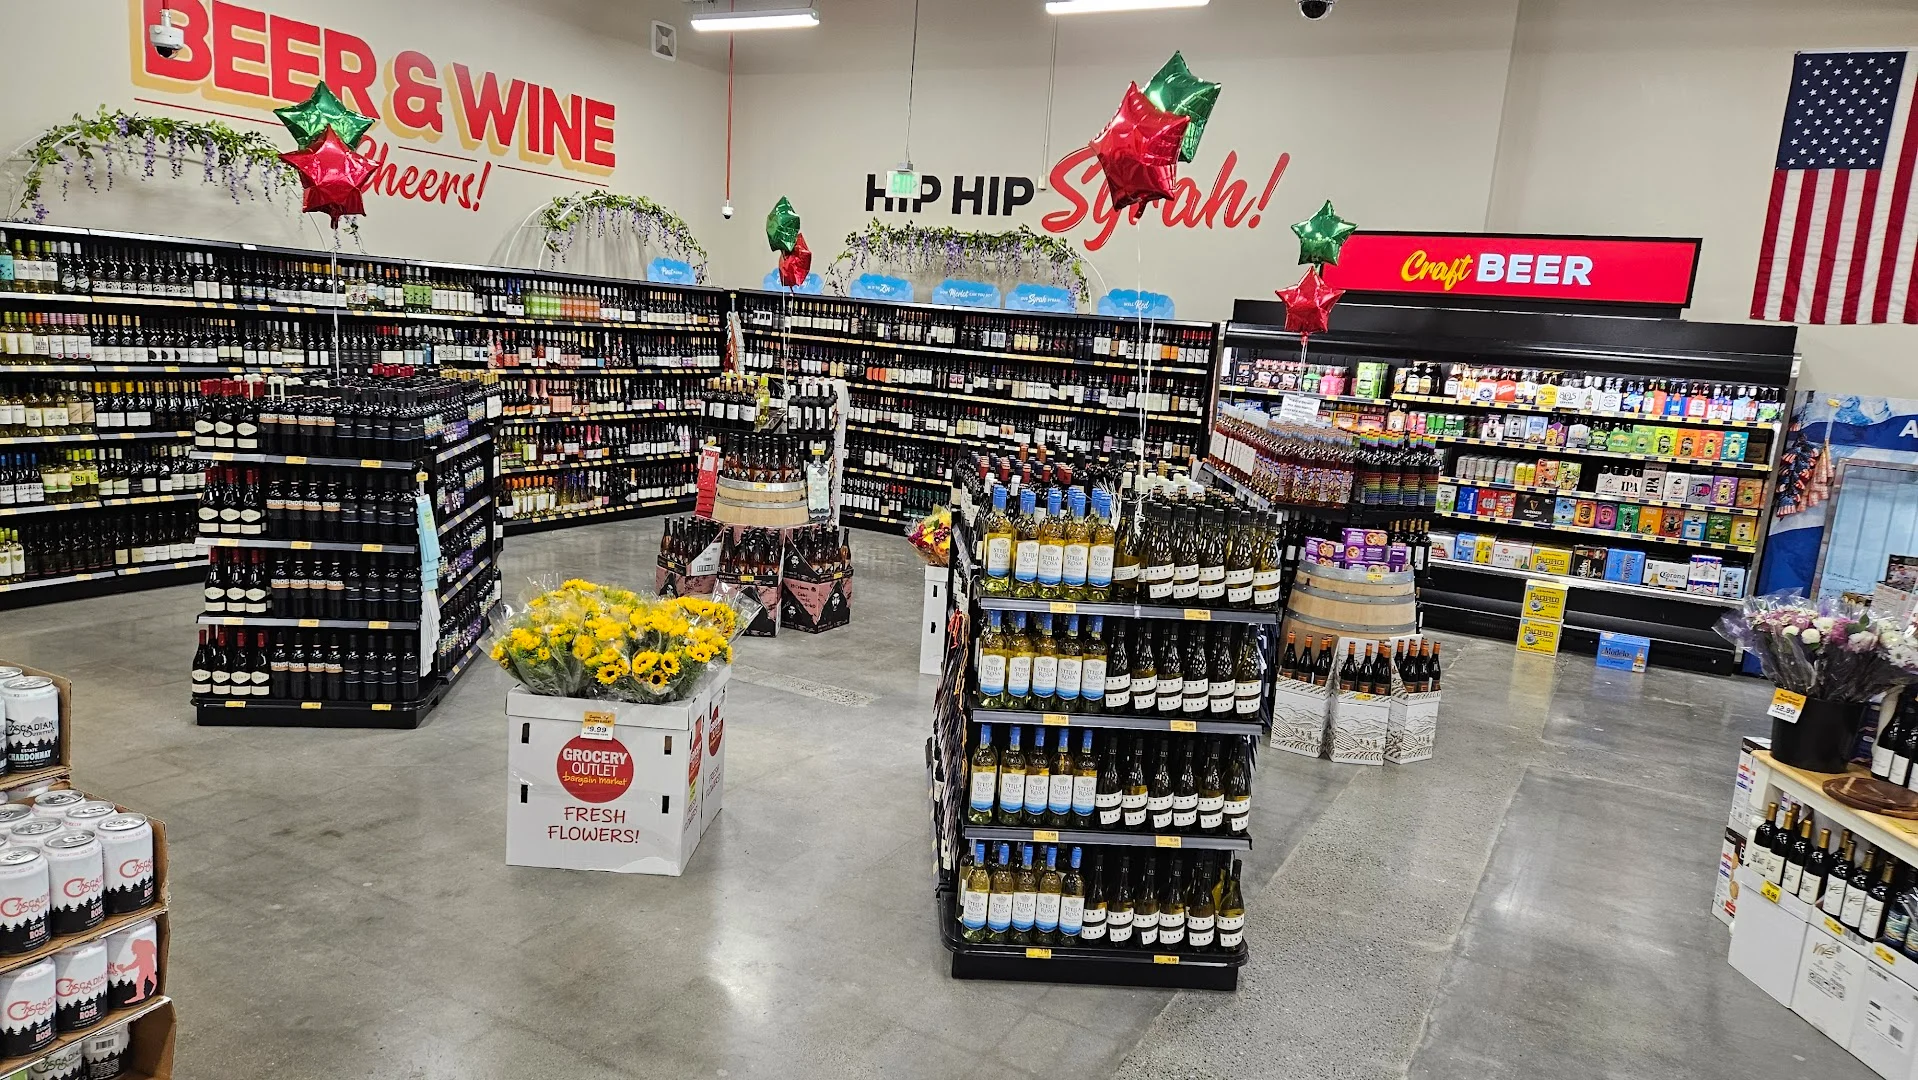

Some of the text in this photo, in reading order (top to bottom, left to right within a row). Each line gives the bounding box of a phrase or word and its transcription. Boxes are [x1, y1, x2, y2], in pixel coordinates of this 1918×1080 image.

[144, 0, 616, 168] BEER & WINE
[951, 175, 1036, 216] HIP
[1401, 250, 1594, 291] Craft BEER
[1620, 481, 1638, 493] IPA
[1660, 571, 1686, 579] Corona
[1605, 646, 1630, 657] Modelo
[8, 749, 52, 761] CHARDONNAY
[562, 747, 628, 765] GROCERY
[571, 761, 618, 777] OUTLET
[562, 771, 627, 786] bargain market
[563, 806, 626, 824] FRESH
[547, 825, 640, 844] FLOWERS!
